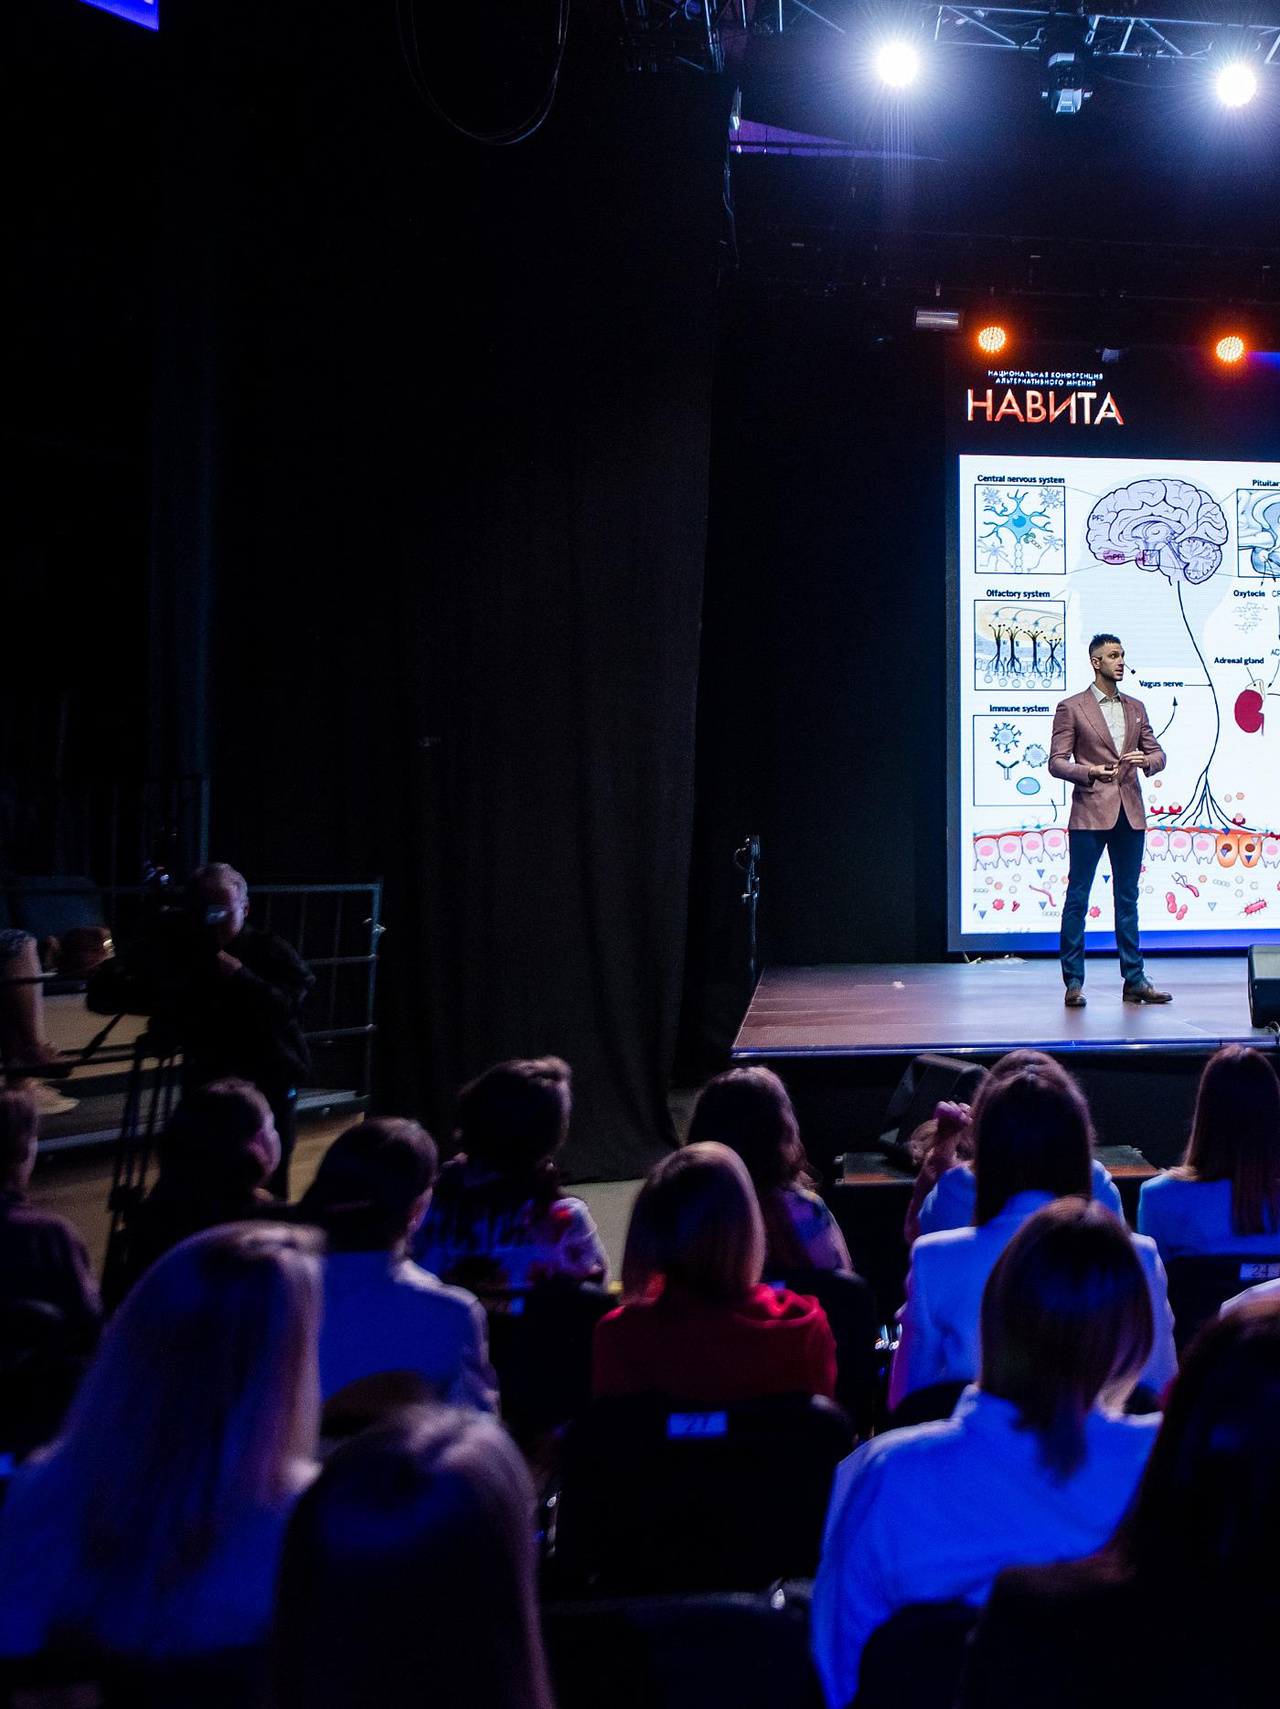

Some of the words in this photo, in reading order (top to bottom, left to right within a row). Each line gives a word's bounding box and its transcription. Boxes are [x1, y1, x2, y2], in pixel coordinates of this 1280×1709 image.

[1051, 372, 1103, 380] КОНФЕРЕНЦИЯ
[995, 378, 1064, 386] АЛЬТЕРНАТИВНОГО
[967, 388, 1124, 425] НАВИТА
[1038, 477, 1065, 485] system
[986, 590, 1021, 598] Olfactory
[1023, 590, 1050, 598] system
[1233, 590, 1265, 598] Oxytocin
[1214, 656, 1242, 664] Adrenal
[1244, 657, 1264, 666] gland
[1138, 680, 1160, 689] Vagus
[1022, 706, 1049, 714] system
[1252, 1264, 1270, 1277] 24
